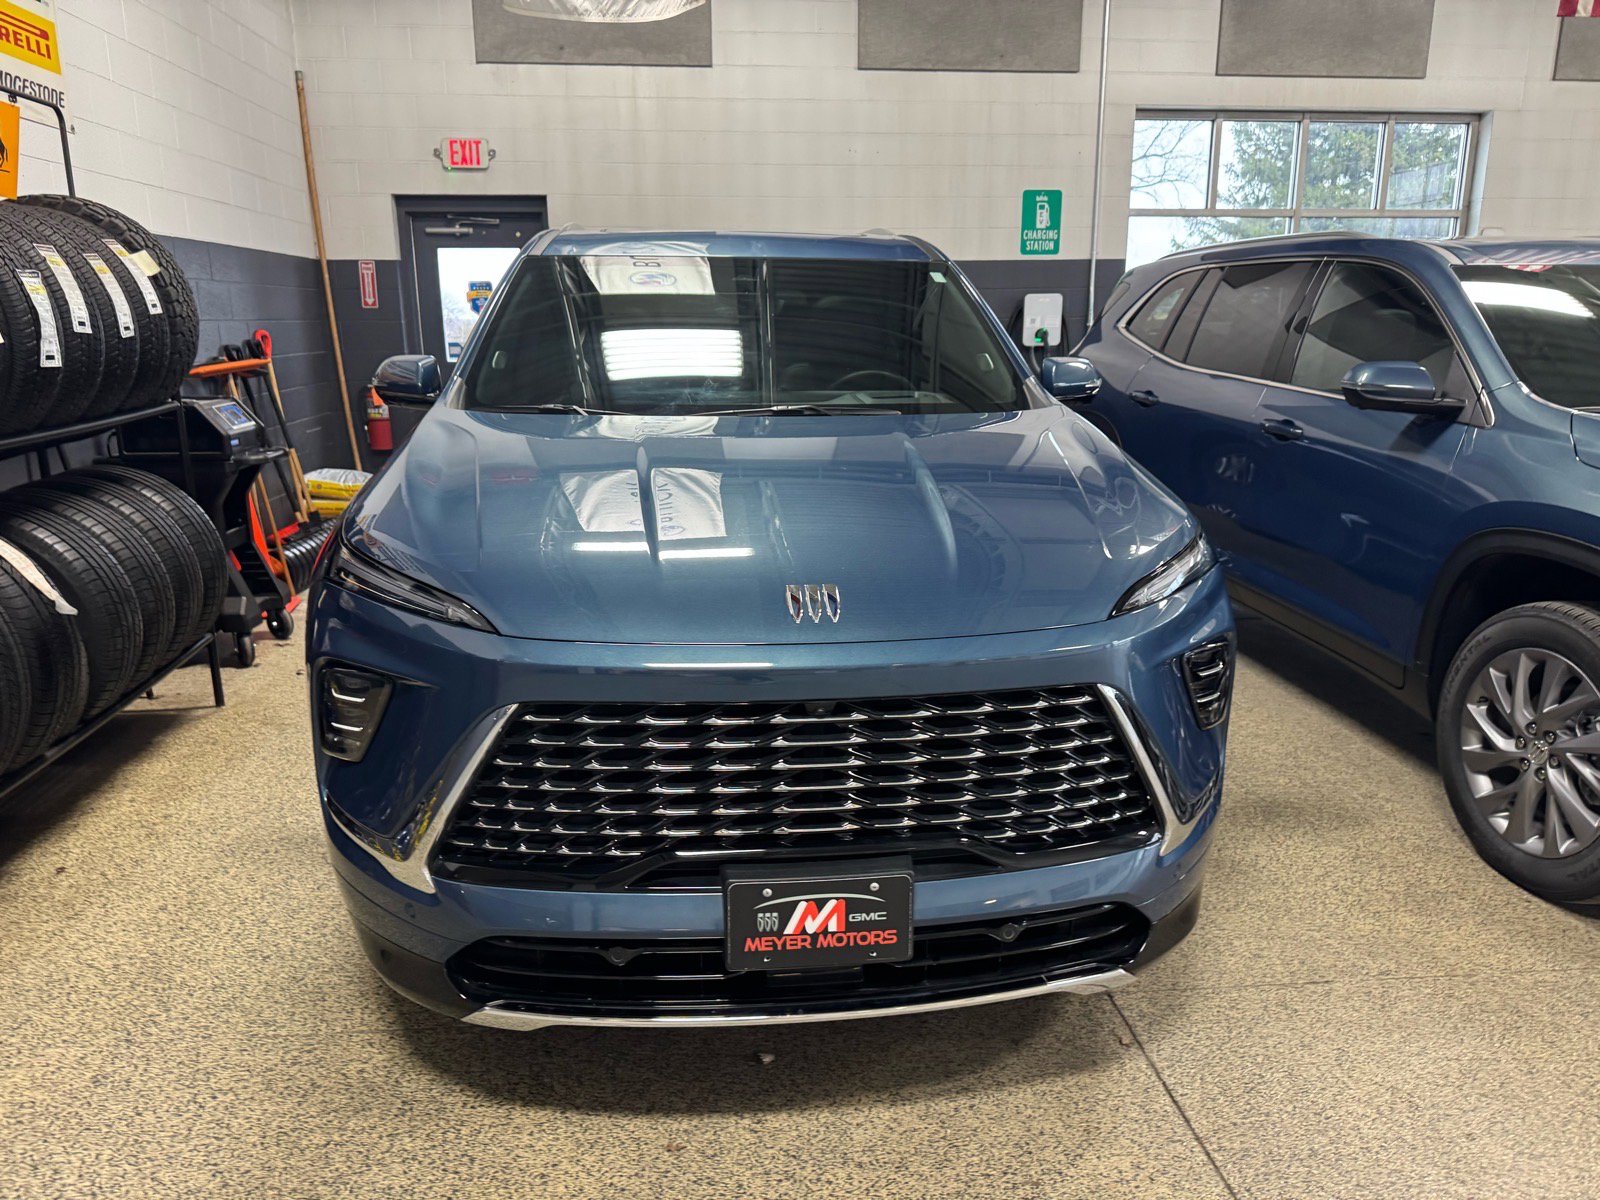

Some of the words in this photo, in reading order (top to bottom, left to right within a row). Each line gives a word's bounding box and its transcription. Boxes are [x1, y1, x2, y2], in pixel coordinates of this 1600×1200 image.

[449, 139, 481, 166] EXIT
[1023, 230, 1058, 240] CHARGING
[1026, 241, 1054, 251] STATION
[848, 911, 888, 922] GMC
[744, 936, 812, 952] MEYER
[816, 930, 898, 948] MOTORS
